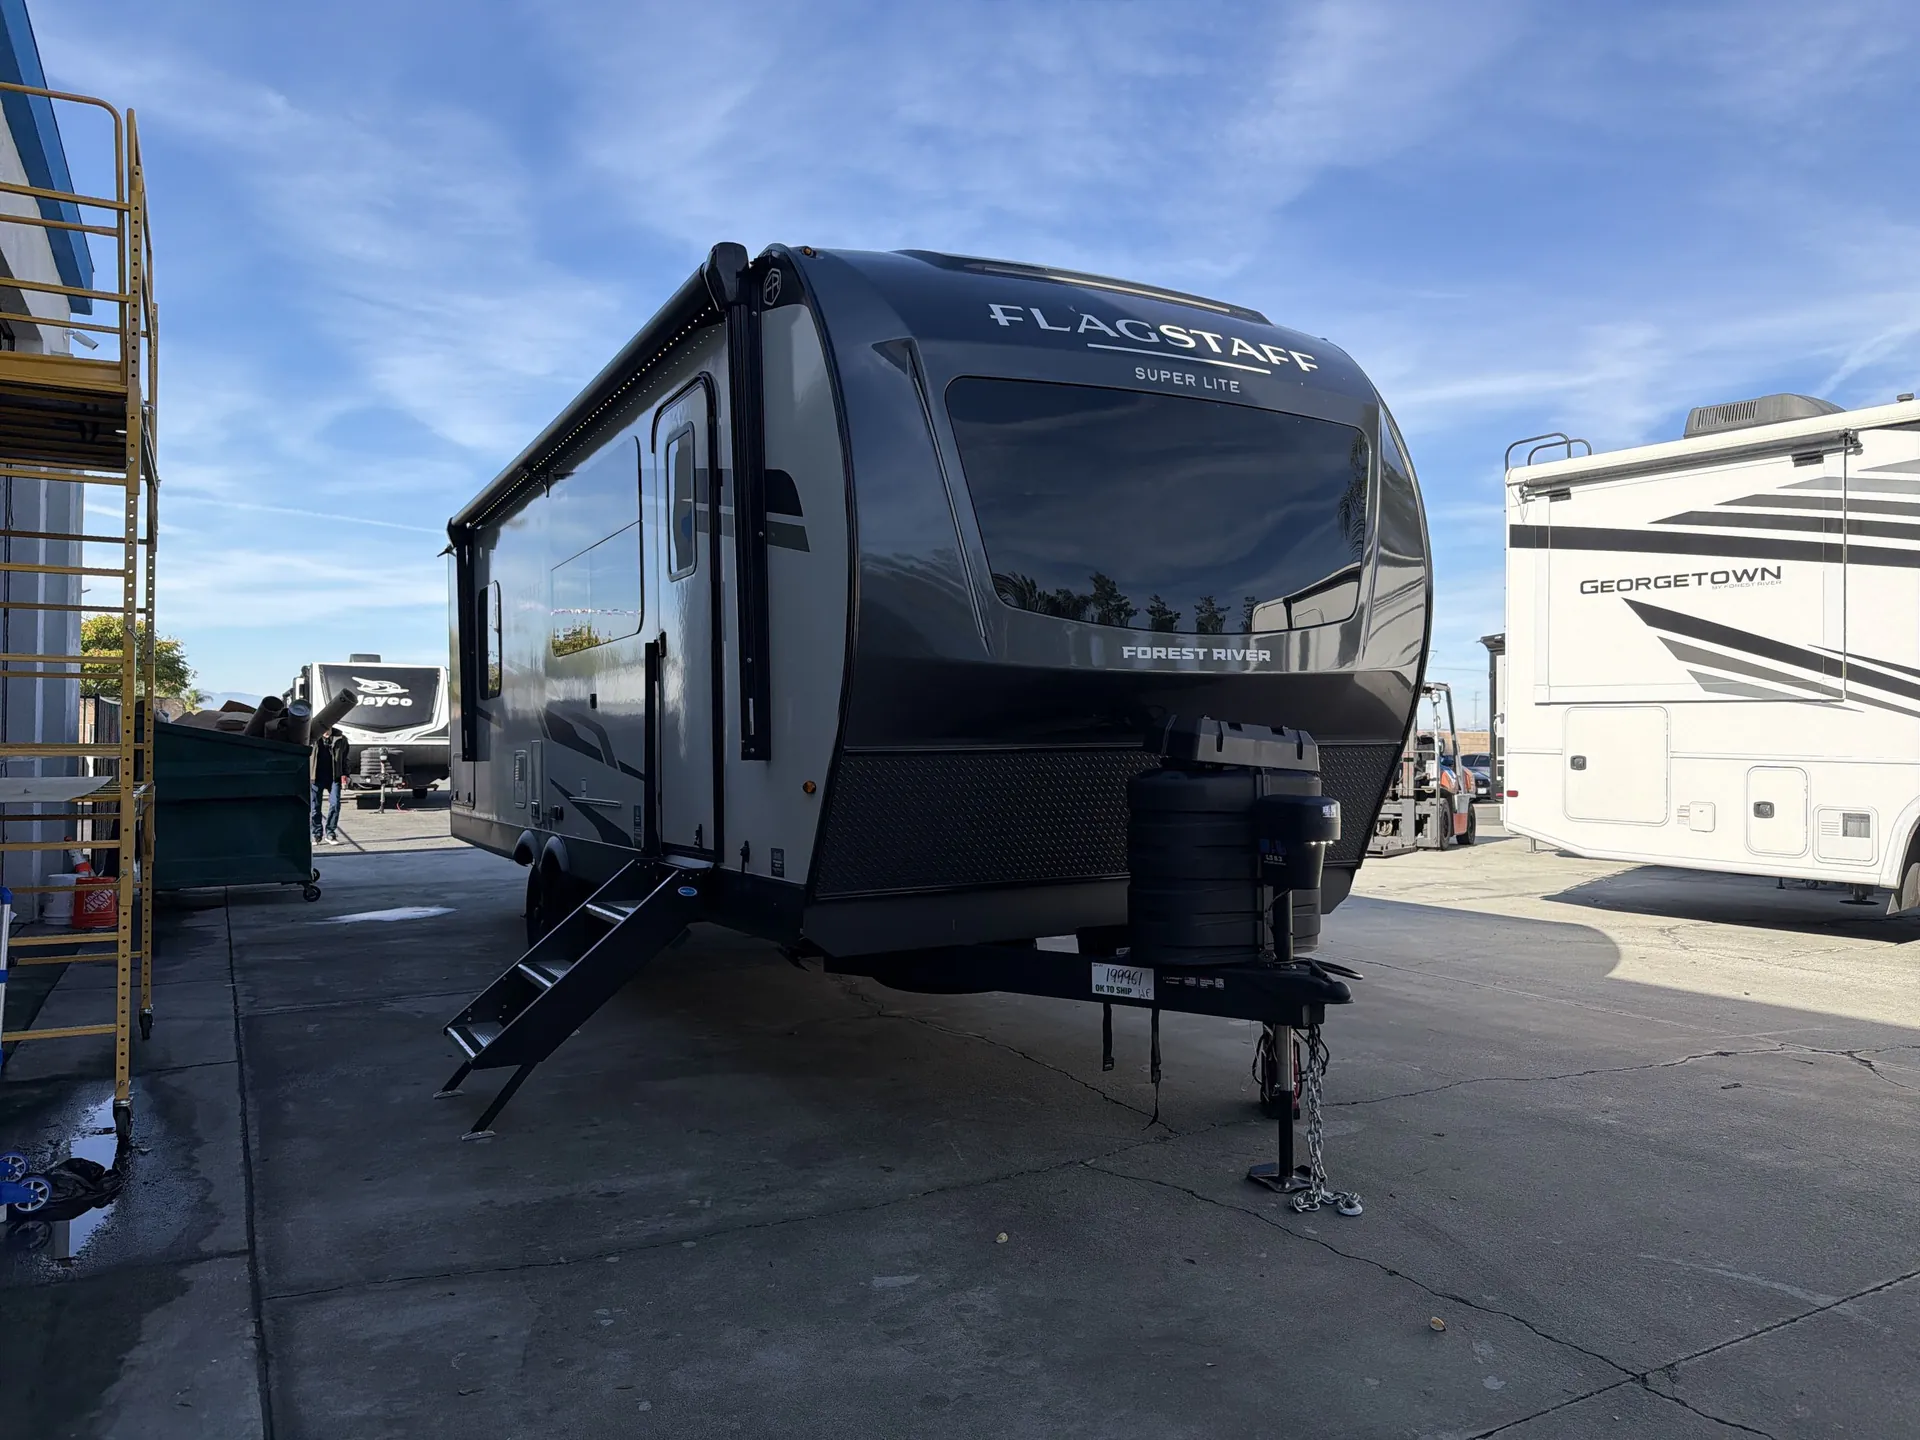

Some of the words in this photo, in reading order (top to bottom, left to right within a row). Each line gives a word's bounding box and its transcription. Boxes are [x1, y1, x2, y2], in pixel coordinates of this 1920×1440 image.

[989, 303, 1319, 372] FLAGSTAFF
[1135, 367, 1197, 387] SUPER
[1203, 376, 1241, 394] LITE
[1580, 566, 1782, 595] GEORGETOWN
[1122, 646, 1208, 660] FOREST
[1212, 648, 1271, 662] RIVER
[356, 695, 412, 707] Jayco
[1095, 984, 1105, 992] OK
[1106, 985, 1115, 993] TO
[1116, 986, 1133, 995] SHIP
